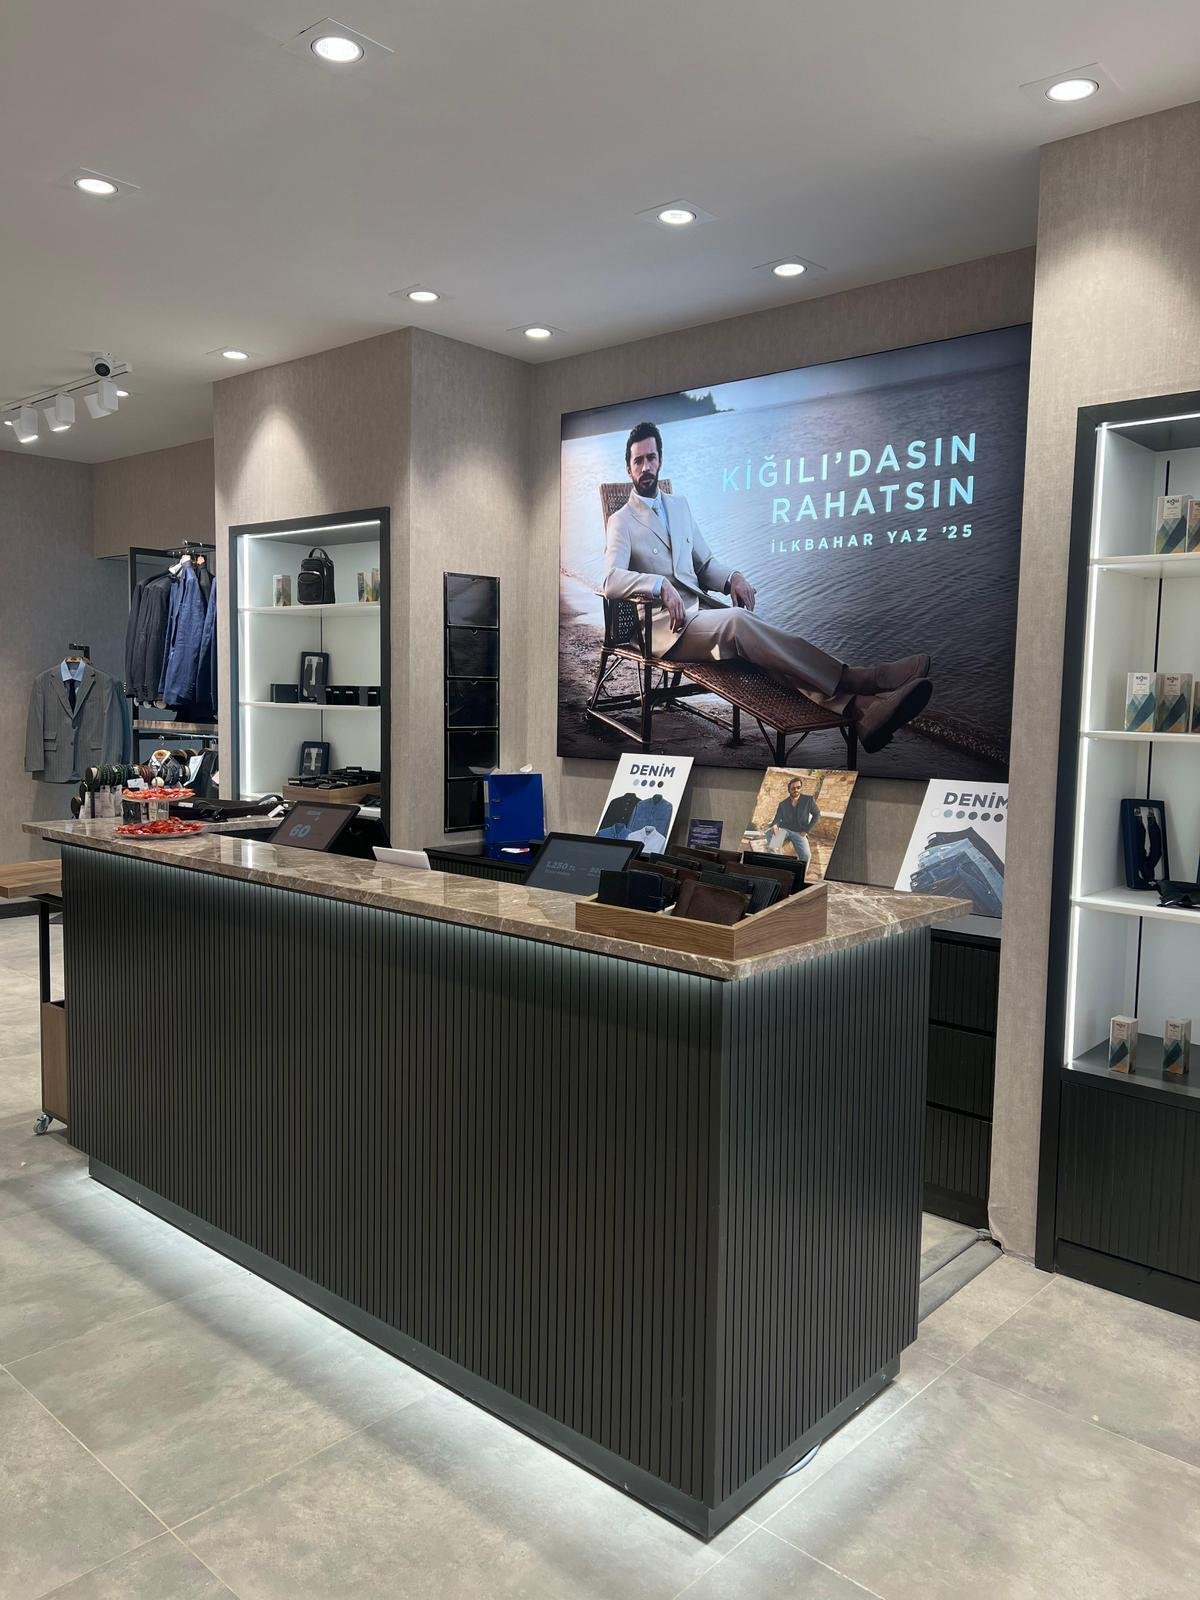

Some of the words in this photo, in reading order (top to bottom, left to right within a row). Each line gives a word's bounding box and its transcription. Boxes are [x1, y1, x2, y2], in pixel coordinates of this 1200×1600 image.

[771, 475, 974, 524] RAHATSIN
[771, 533, 873, 553] İLKBAHAR
[887, 528, 928, 543] YAZ
[629, 763, 675, 778] DENİM
